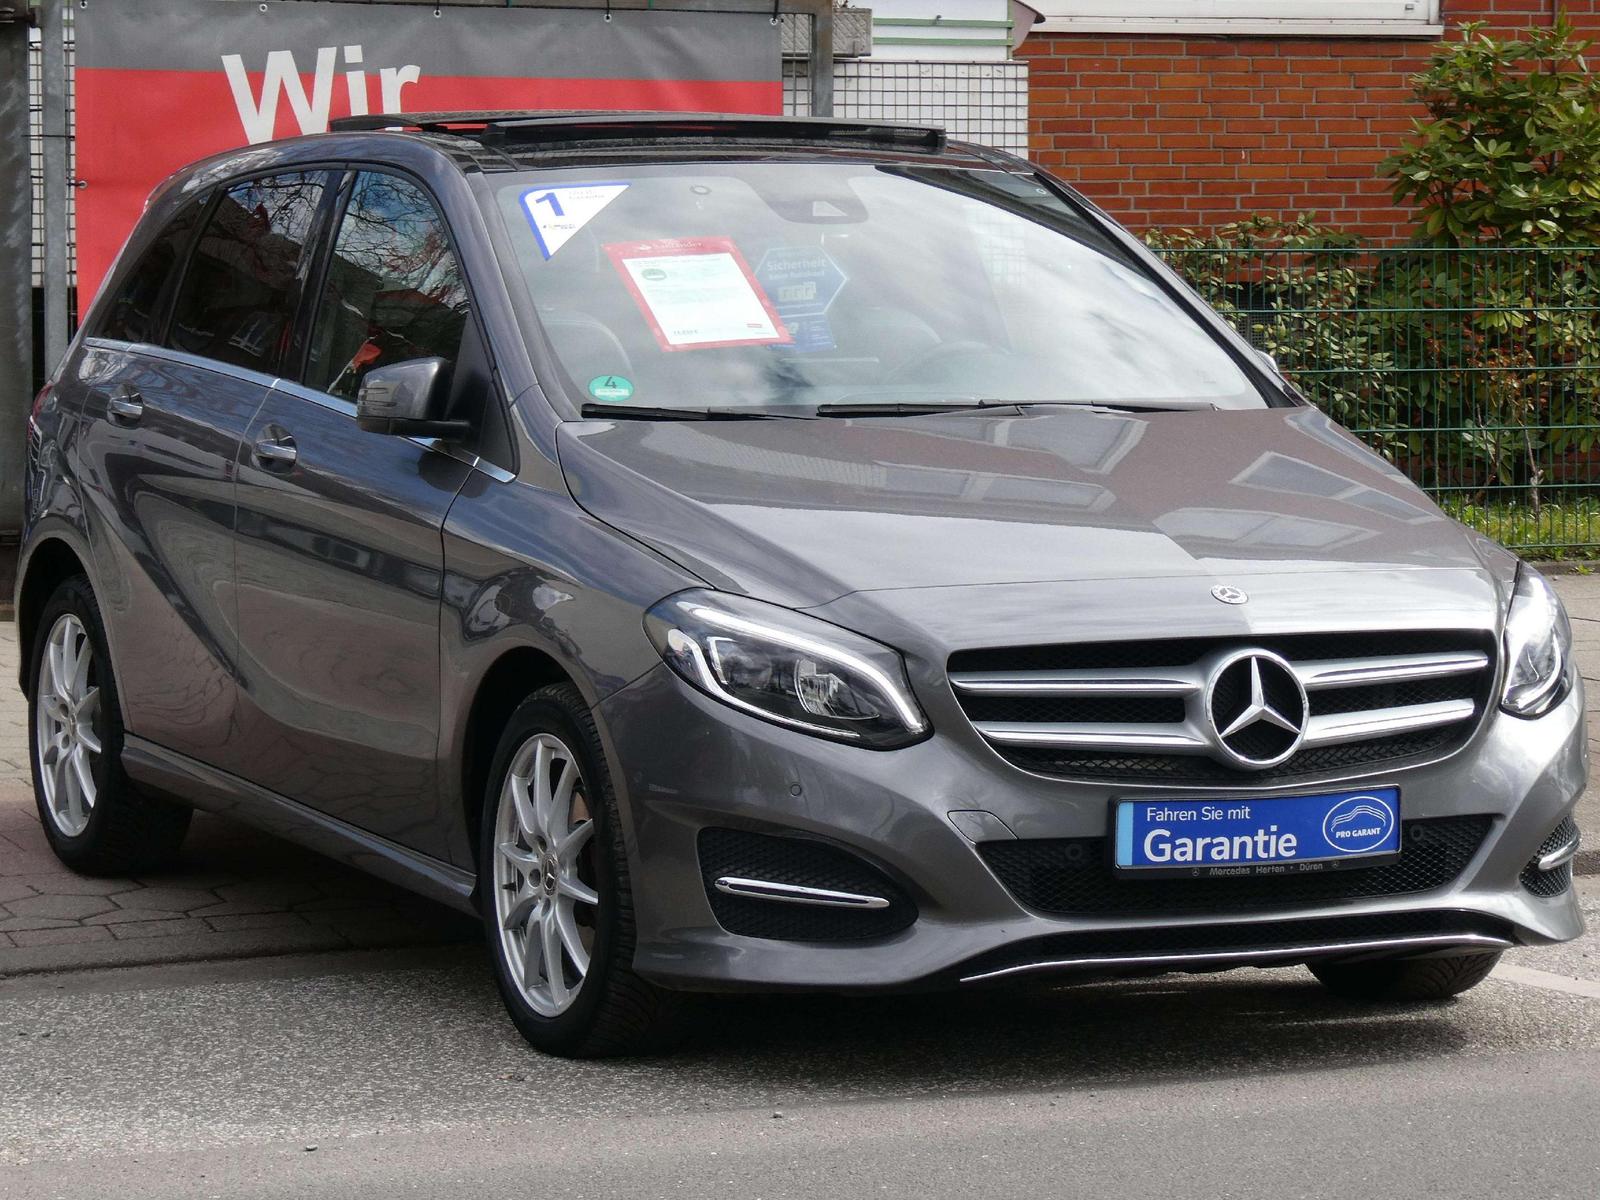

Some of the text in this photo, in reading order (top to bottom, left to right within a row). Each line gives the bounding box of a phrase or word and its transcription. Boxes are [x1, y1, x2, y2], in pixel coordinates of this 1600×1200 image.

[221, 45, 420, 145] Wir
[535, 192, 565, 216] 1
[604, 376, 617, 389] 4
[1147, 805, 1251, 821] Fahren Sie mit
[1336, 827, 1381, 838] PRO GARANT
[1144, 825, 1297, 862] Garantie
[1209, 867, 1250, 876] Mercedes
[1300, 863, 1323, 872] Düren
